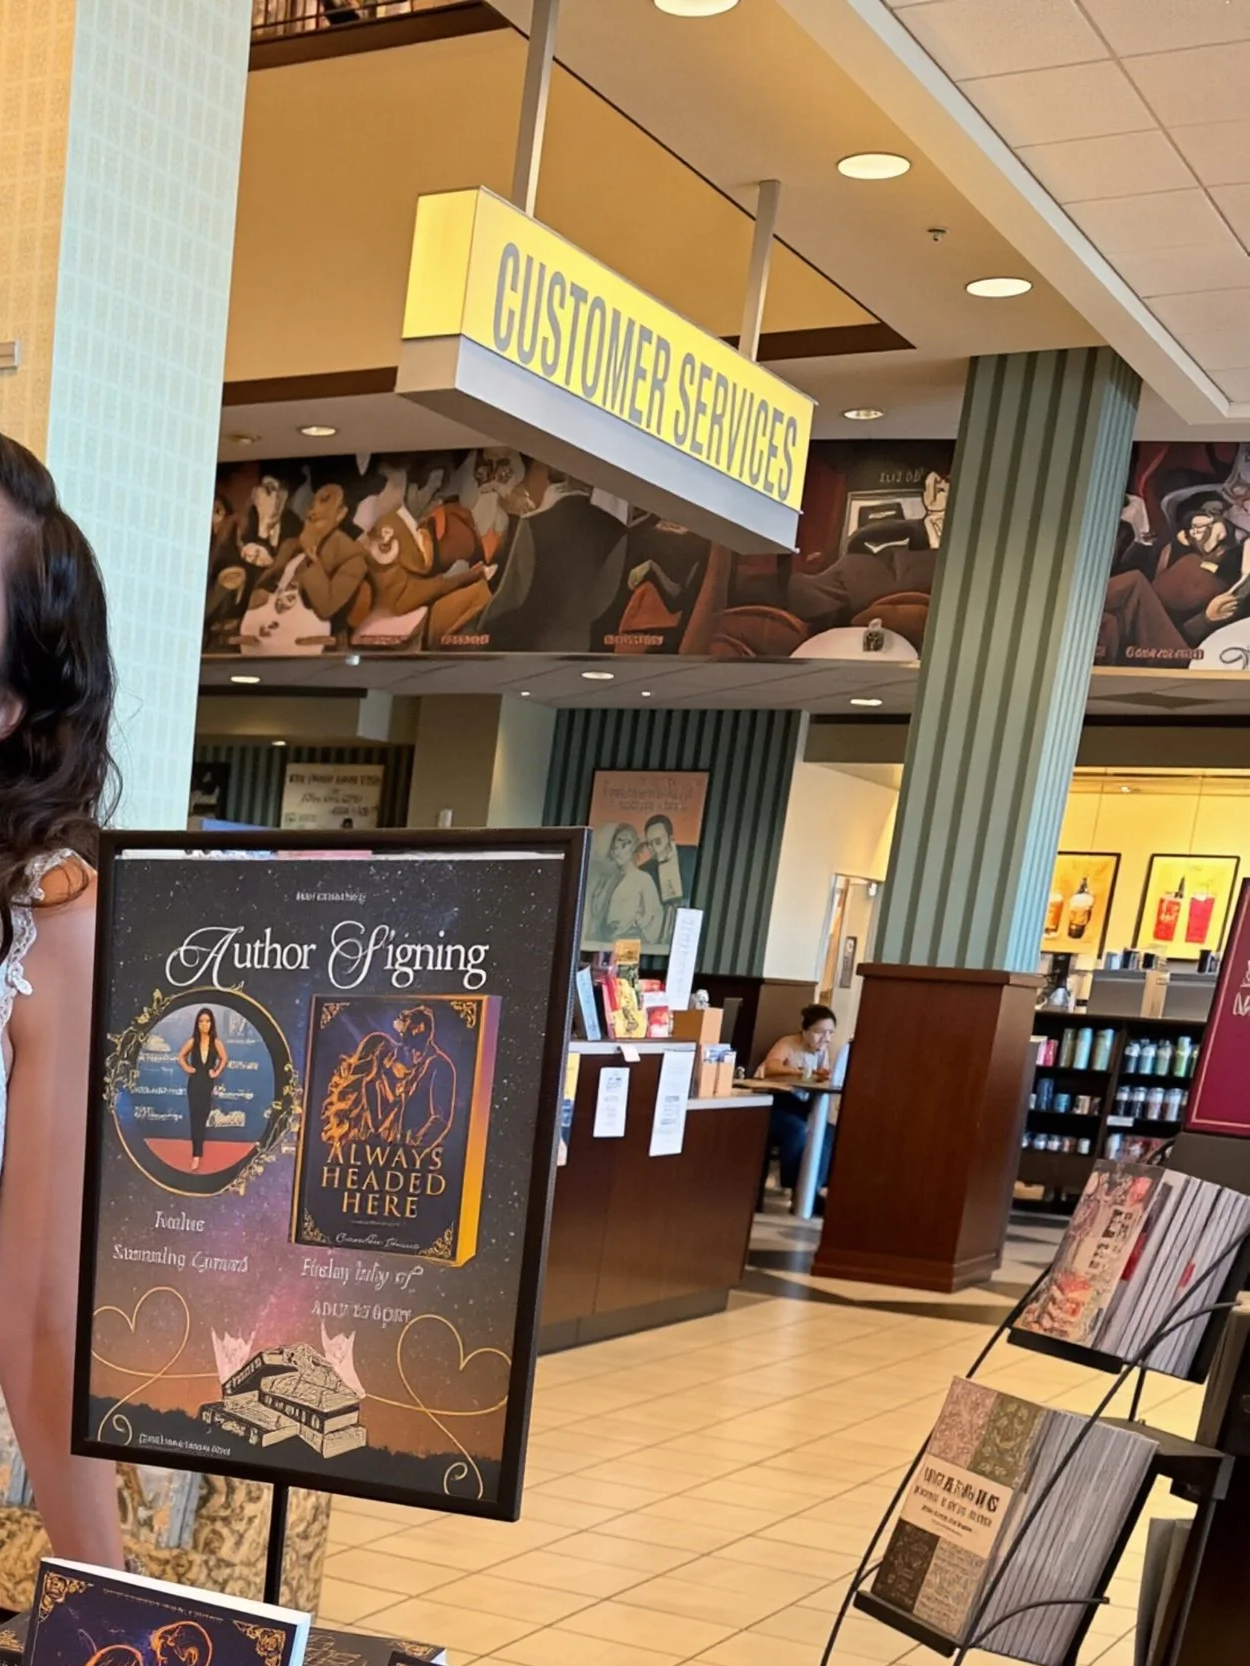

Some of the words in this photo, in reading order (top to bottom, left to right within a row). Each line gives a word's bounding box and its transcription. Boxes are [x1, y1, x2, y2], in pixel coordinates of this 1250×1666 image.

[493, 242, 671, 436] CUSTOMER
[673, 352, 798, 501] SERVICES
[165, 926, 317, 992] Author
[327, 920, 490, 990] Signing
[326, 1142, 444, 1171] ALWAYS
[320, 1166, 447, 1196] HEADED
[341, 1191, 419, 1219] HERE
